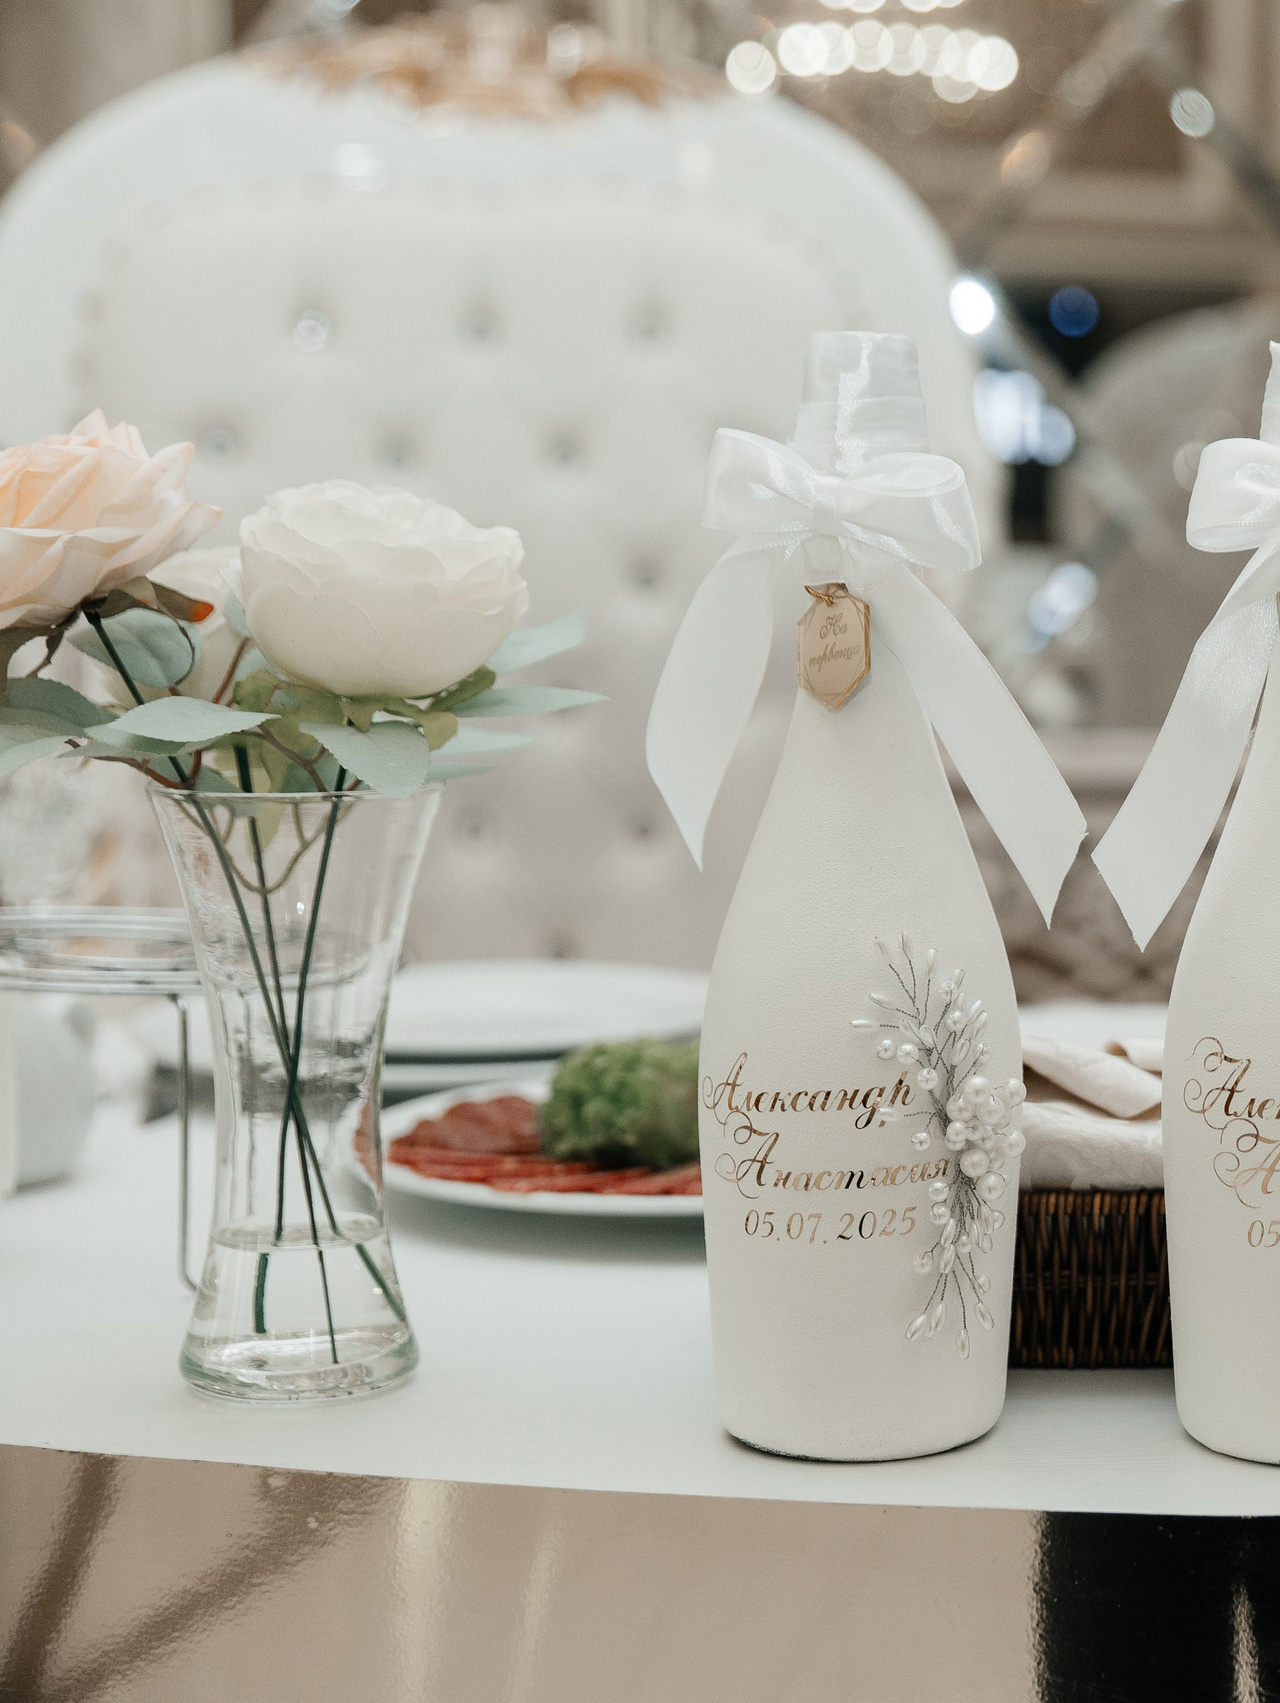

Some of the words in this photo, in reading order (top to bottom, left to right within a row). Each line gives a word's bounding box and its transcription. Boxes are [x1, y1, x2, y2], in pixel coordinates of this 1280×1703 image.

[819, 611, 848, 640] На
[702, 1051, 917, 1130] Александр
[714, 1110, 951, 1200] Анастасия
[744, 1205, 918, 1245] 05.07.2025
